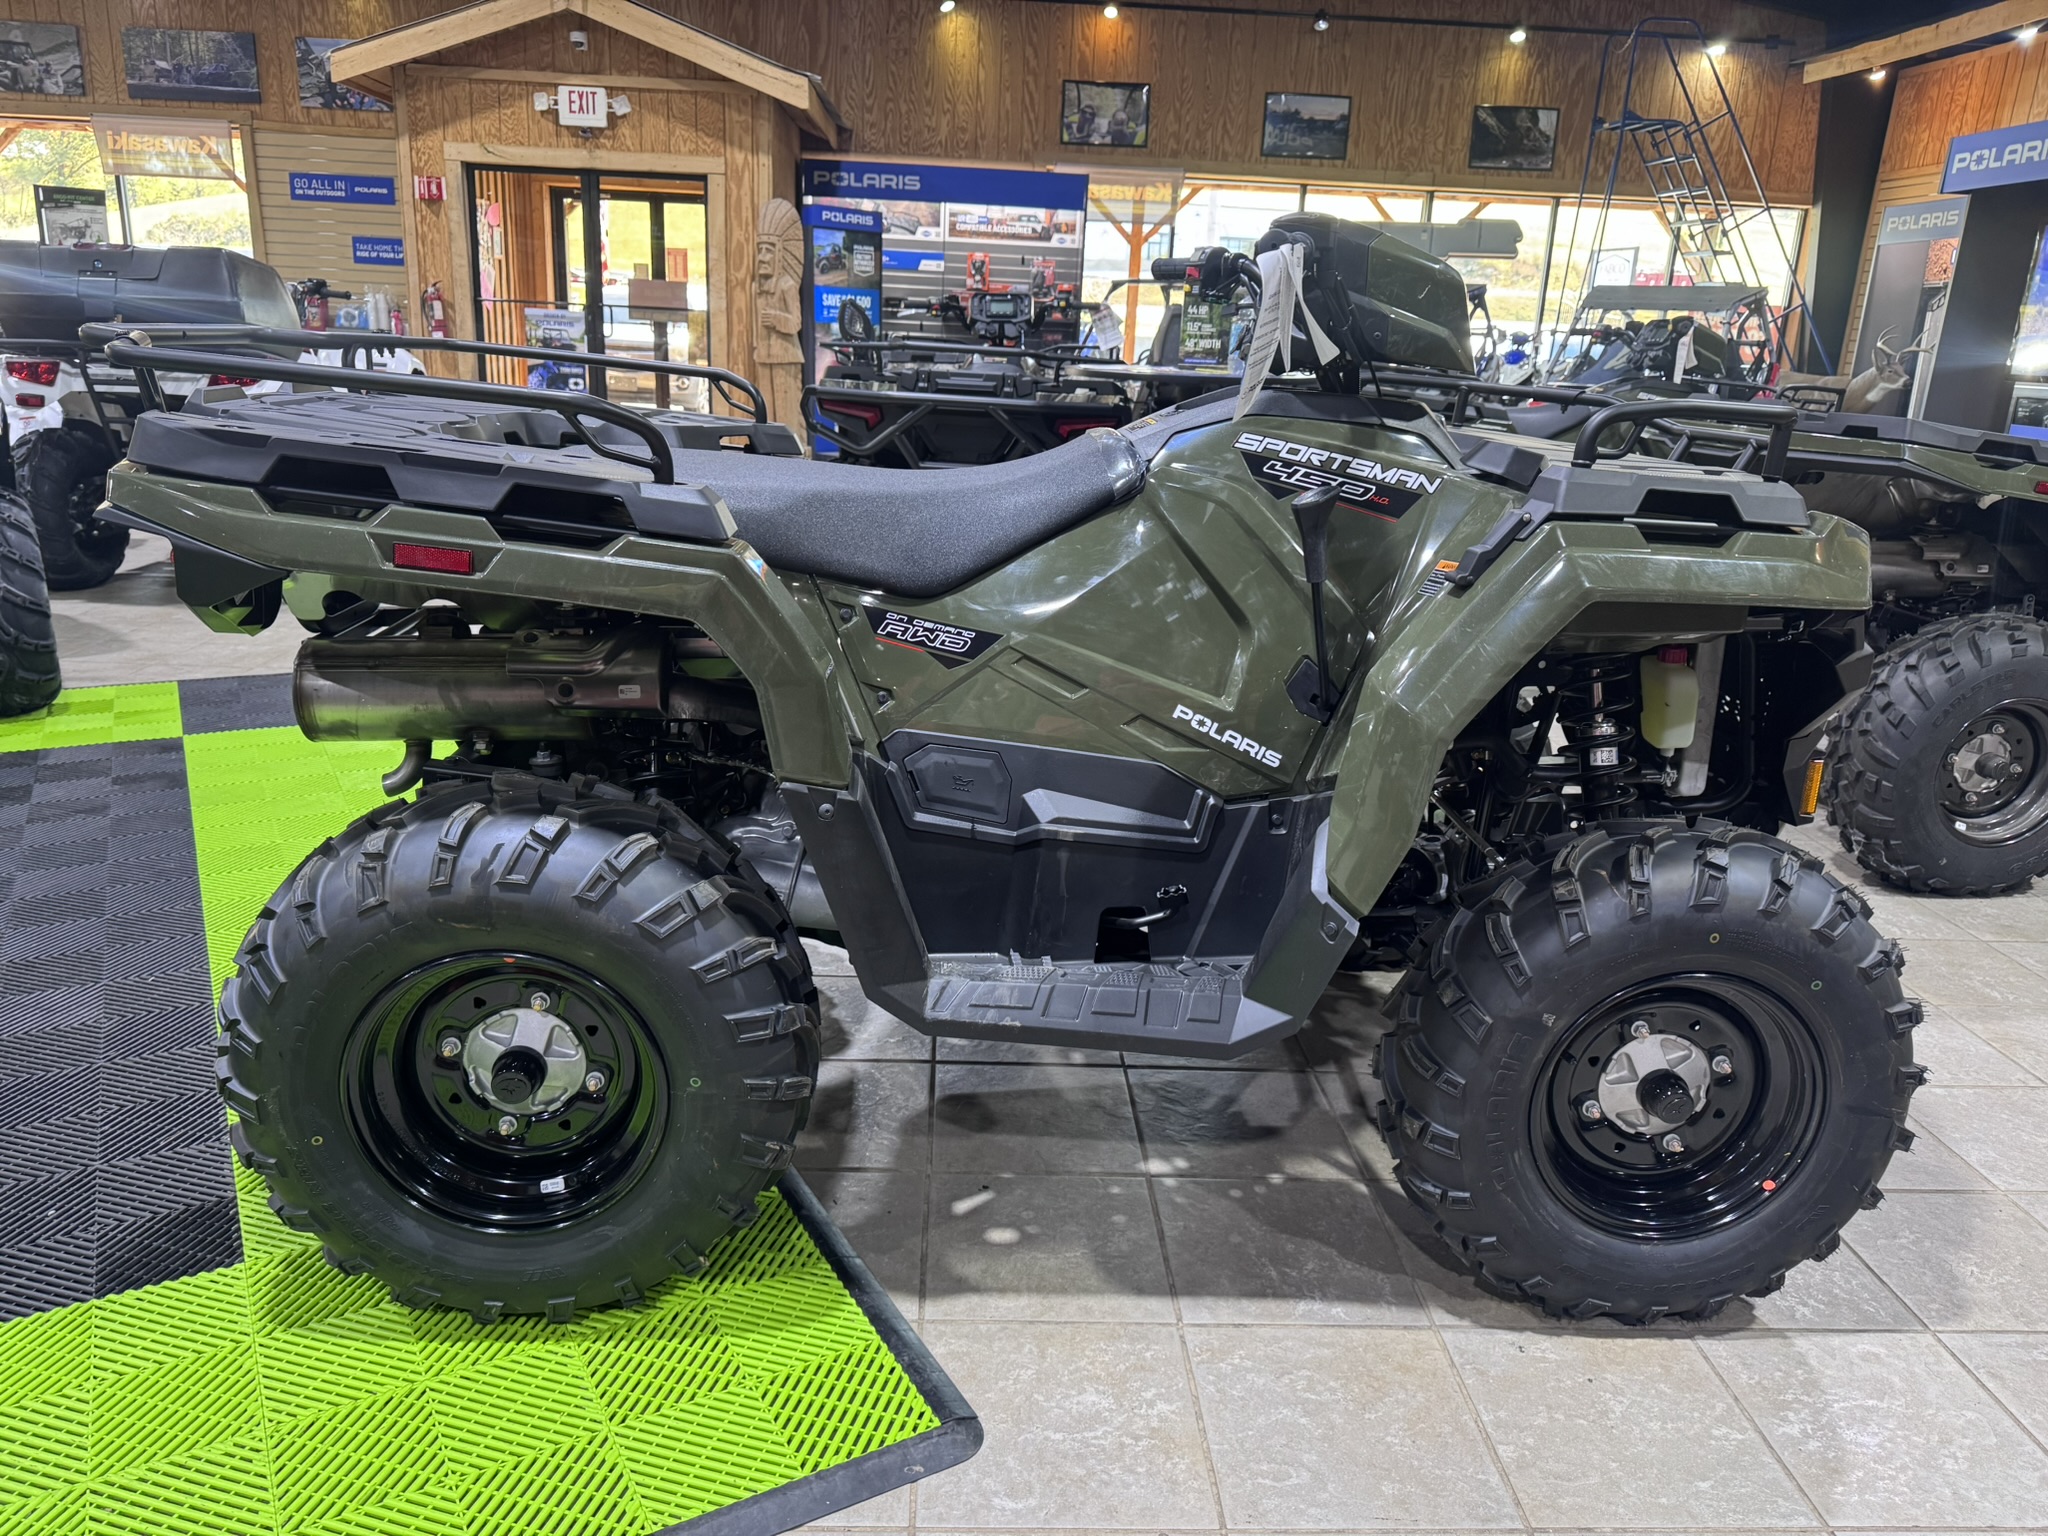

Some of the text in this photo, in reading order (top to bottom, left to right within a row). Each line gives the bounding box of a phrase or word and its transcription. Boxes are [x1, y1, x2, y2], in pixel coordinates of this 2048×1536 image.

[568, 90, 598, 115] EXIT
[1951, 138, 2048, 175] POLARI
[294, 178, 345, 190] GO ALL IN
[354, 186, 389, 194] POLARIS
[813, 170, 921, 191] POLARIS
[316, 189, 346, 197] OUTDOORS
[822, 211, 874, 226] POLARIS
[1886, 210, 1960, 233] POLARIS
[356, 243, 404, 253] TAKE HOME TH
[822, 293, 841, 306] SAVE
[1187, 305, 1209, 315] 44 HP
[1199, 339, 1221, 349] WIDTH
[1233, 432, 1444, 494] SPORTSMAN
[1263, 461, 1376, 500] 450
[877, 619, 971, 652] AWD
[886, 612, 976, 638] ON DEMAND
[1172, 704, 1283, 768] POLARIS
